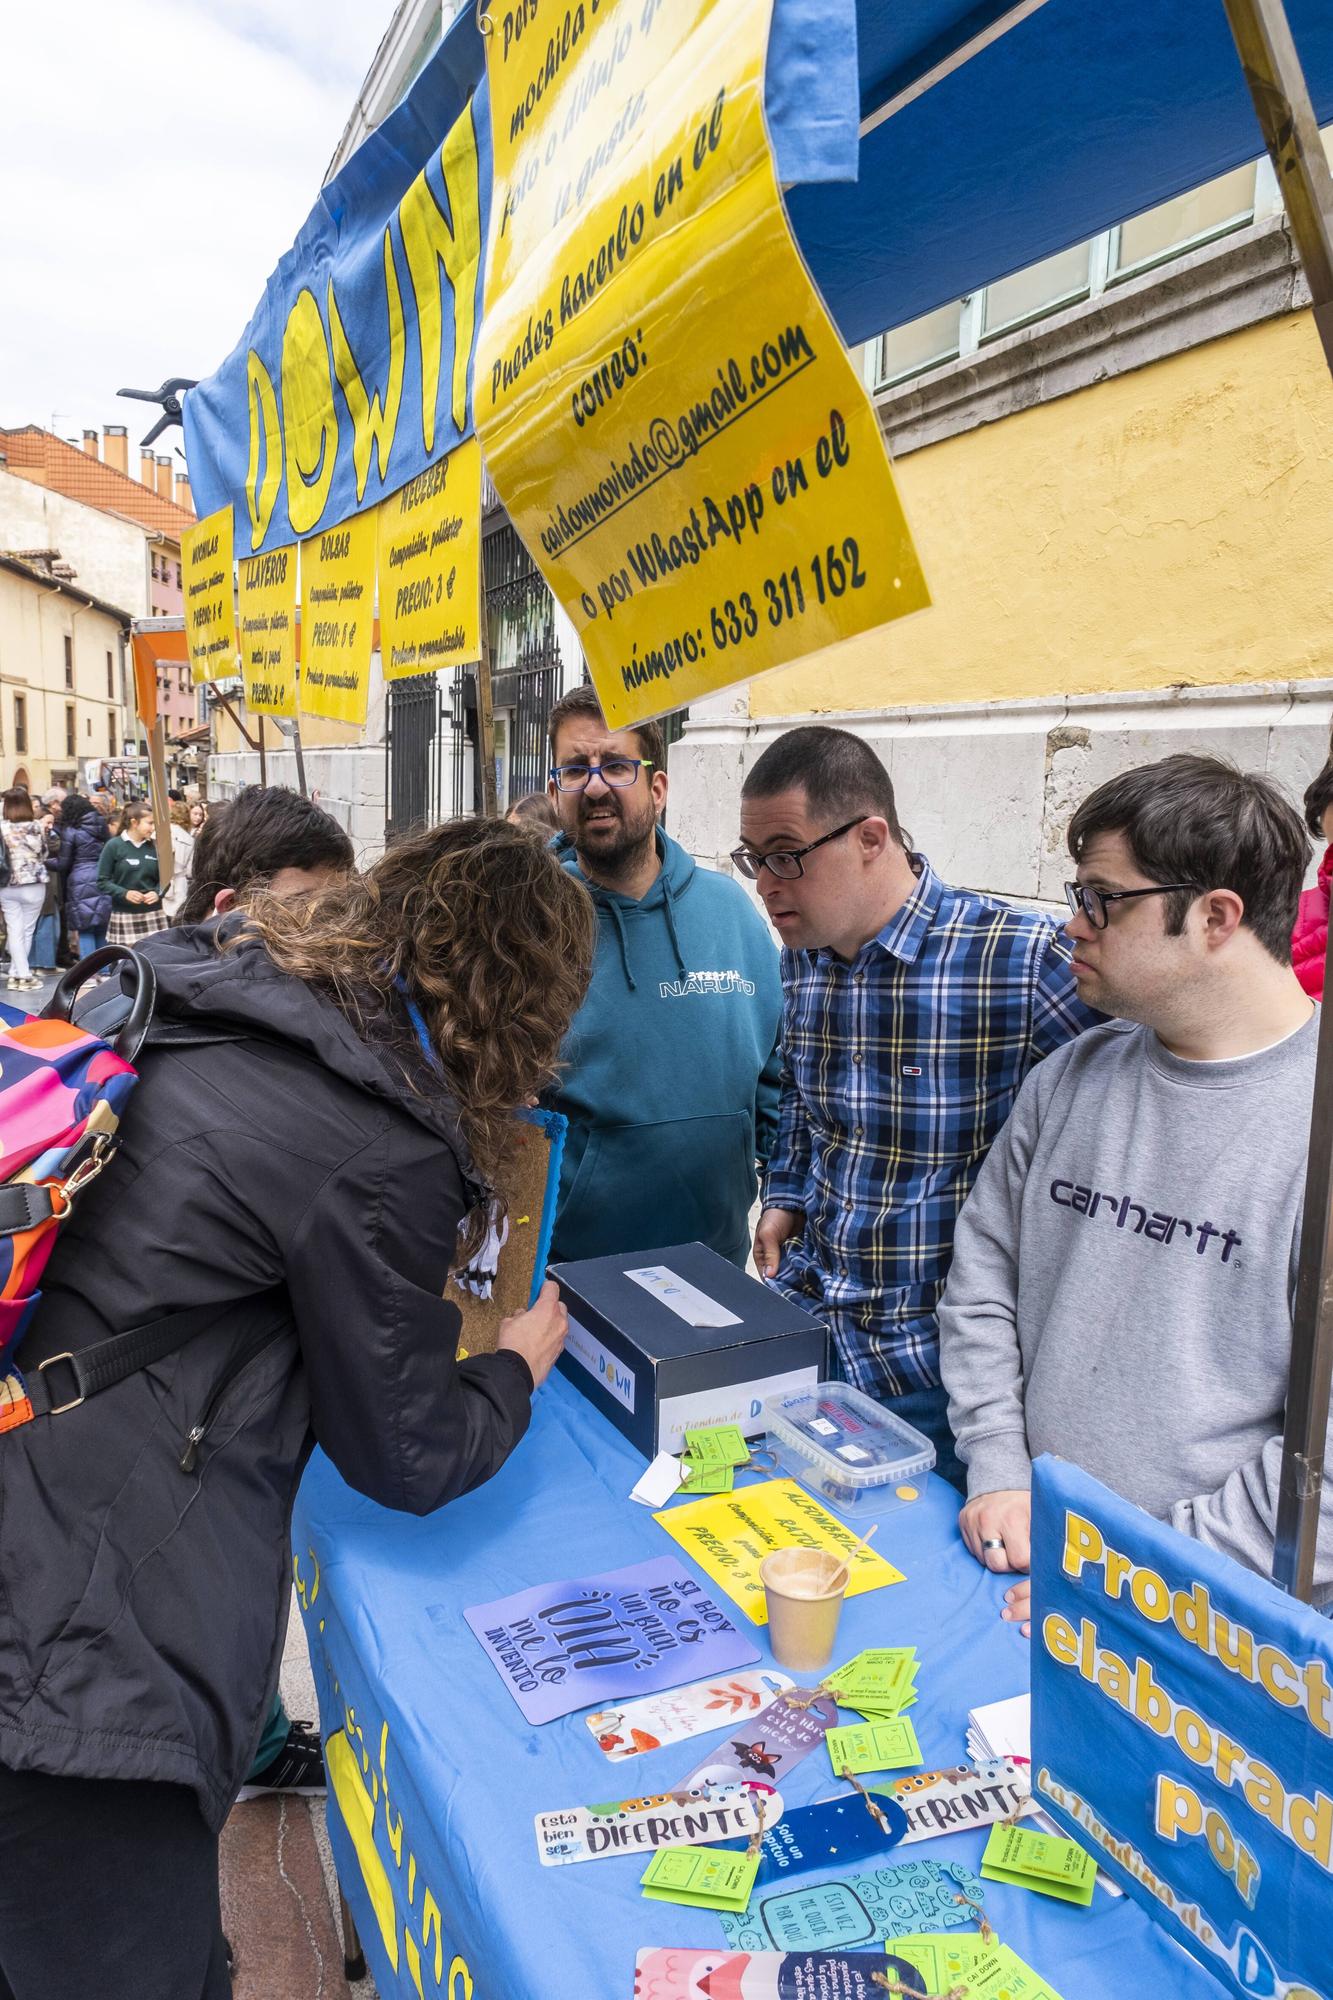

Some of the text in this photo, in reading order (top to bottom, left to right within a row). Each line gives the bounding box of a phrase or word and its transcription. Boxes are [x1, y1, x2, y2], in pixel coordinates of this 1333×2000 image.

[509, 3, 585, 144] mochila
[491, 85, 725, 403] Puedes hacerlo en el
[246, 93, 482, 553] DOWN
[570, 327, 649, 428] correo:
[540, 324, 816, 554] caidownoviedo@gmail.com
[581, 408, 851, 620] o por WhastApp en el
[246, 553, 288, 591] LLAVEROS
[395, 575, 434, 620] PRECIO:
[446, 566, 456, 600] €
[312, 622, 340, 648] PRECIO:
[348, 621, 356, 648] €
[622, 536, 867, 692] número: 633 311 162
[251, 683, 273, 705] PRECIO:
[659, 977, 756, 998] NARUTO
[1050, 1179, 1242, 1263] carhartt
[685, 1526, 739, 1569] PRECIO:
[648, 1585, 707, 1645] no es
[674, 1580, 735, 1634] SI HOY
[484, 1627, 540, 1693] INVENTO
[508, 1617, 567, 1686] me lo
[544, 1829, 574, 1843] bien
[586, 1807, 749, 1853] DIFERENTE
[763, 1830, 789, 1867] apítulo
[776, 1824, 803, 1859] Solo un
[1155, 1773, 1260, 1906] por
[799, 1899, 817, 1910] ME
[824, 1893, 856, 1930] ESTA VEZ
[794, 1966, 802, 1986] este
[804, 1974, 815, 1992] que
[826, 1958, 840, 1993] página
[838, 1960, 852, 1996] guarda
[966, 1972, 980, 1983] CAI
[979, 1957, 999, 1975] DOWN
